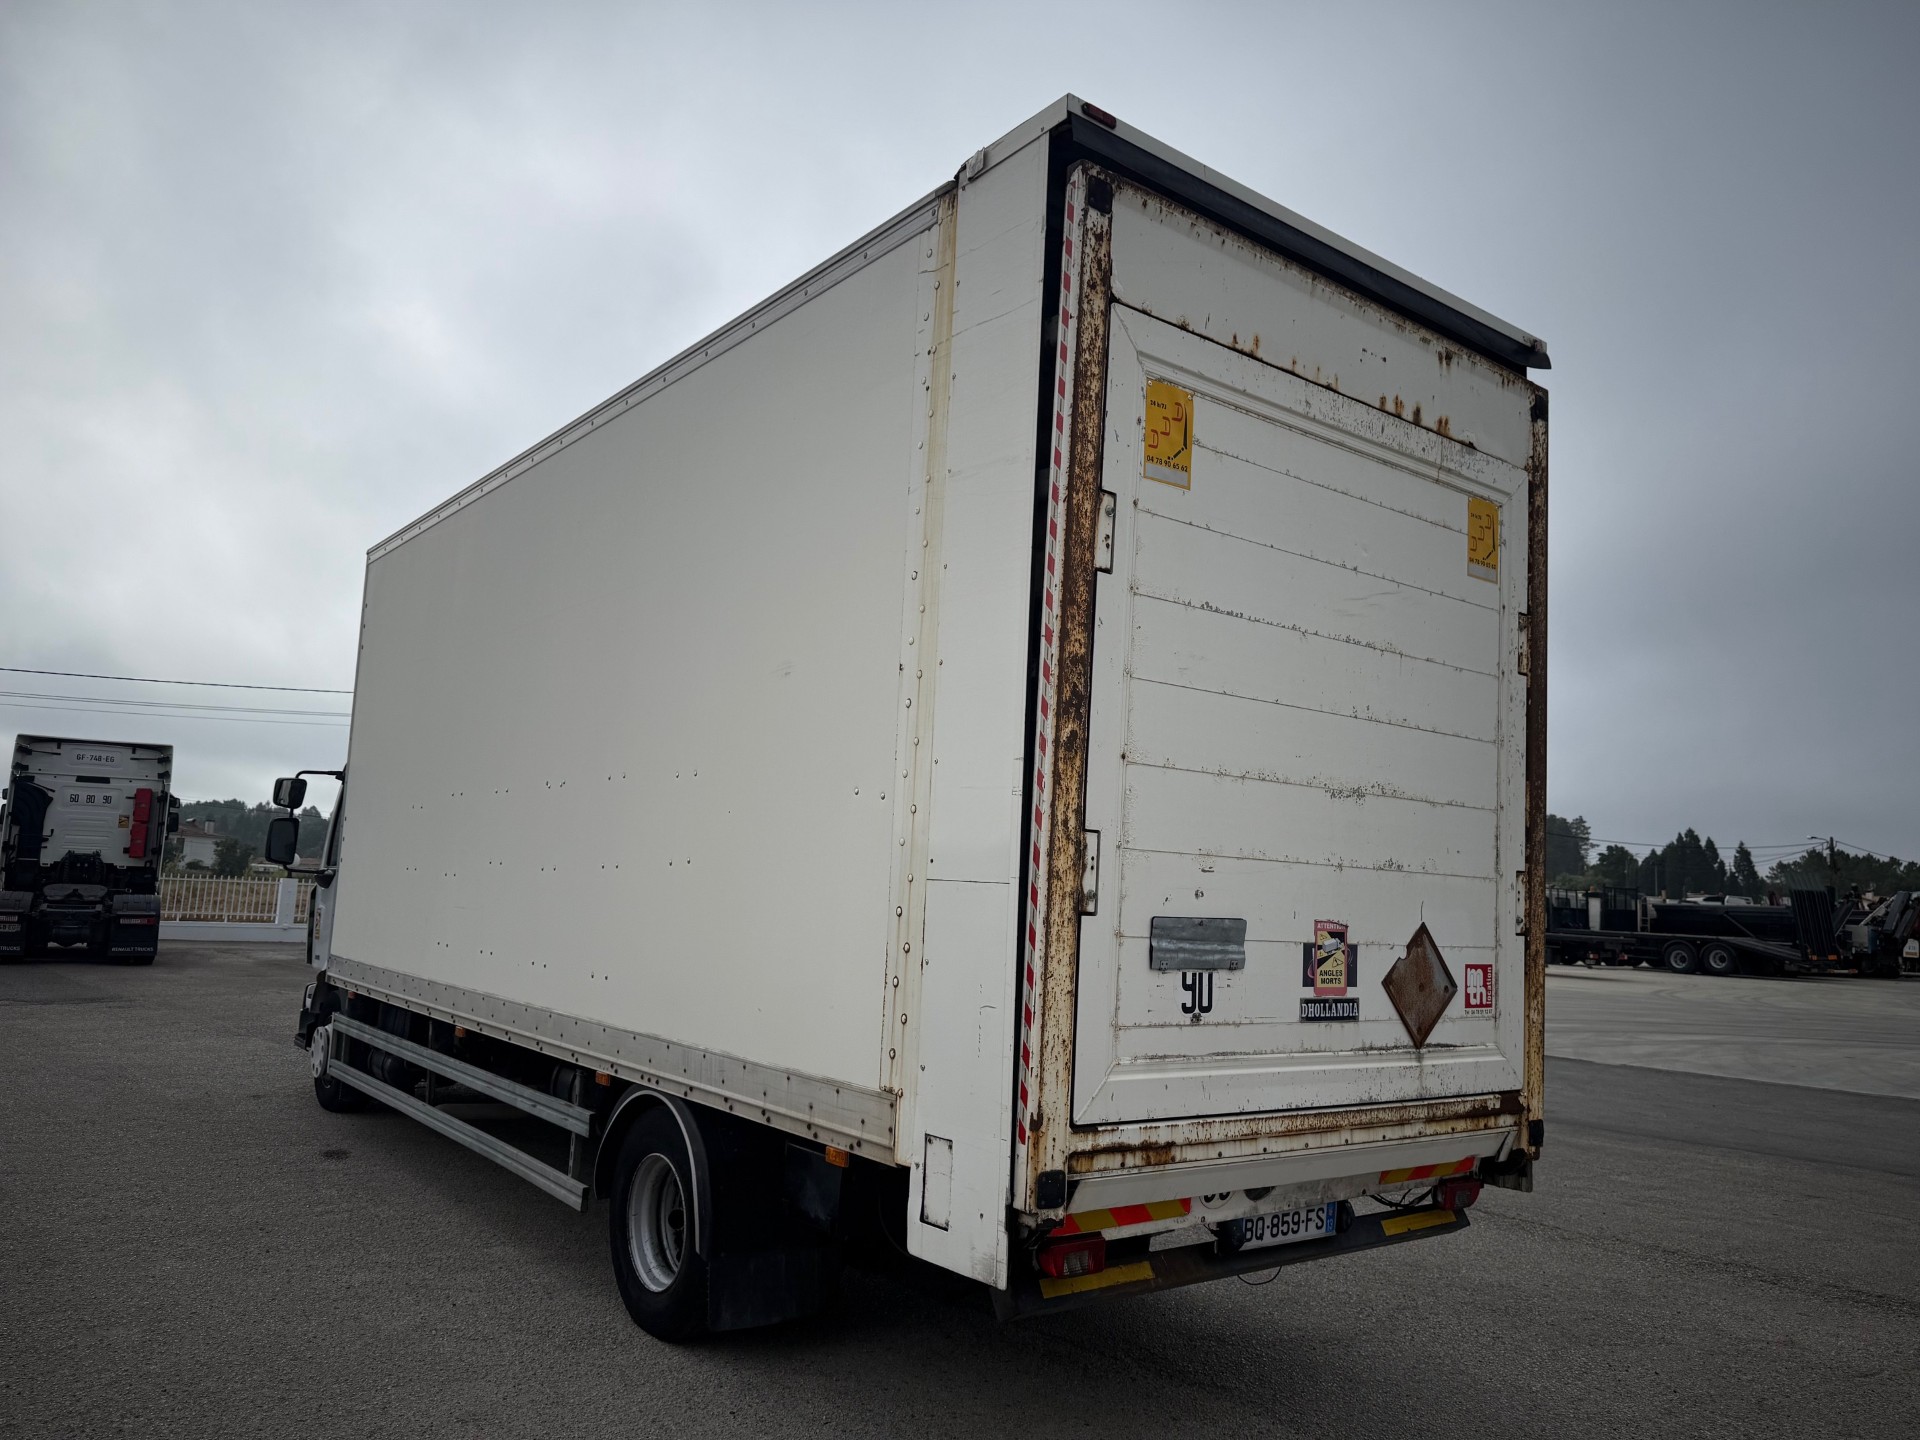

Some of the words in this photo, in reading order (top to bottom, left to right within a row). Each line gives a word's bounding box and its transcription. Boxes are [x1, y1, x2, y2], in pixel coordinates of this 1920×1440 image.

[1146, 455, 1154, 463] 04
[1155, 457, 1163, 465] 78
[1163, 460, 1171, 468] 90
[1172, 462, 1180, 470] 65
[1180, 464, 1188, 472] 62
[69, 793, 80, 803] 60
[86, 794, 95, 804] 80
[102, 795, 112, 804] 90
[1319, 969, 1343, 978] ANGLES
[1320, 977, 1342, 985] MORTS
[1181, 971, 1213, 1014] 90
[1301, 1002, 1359, 1018] DHOLLANDIA
